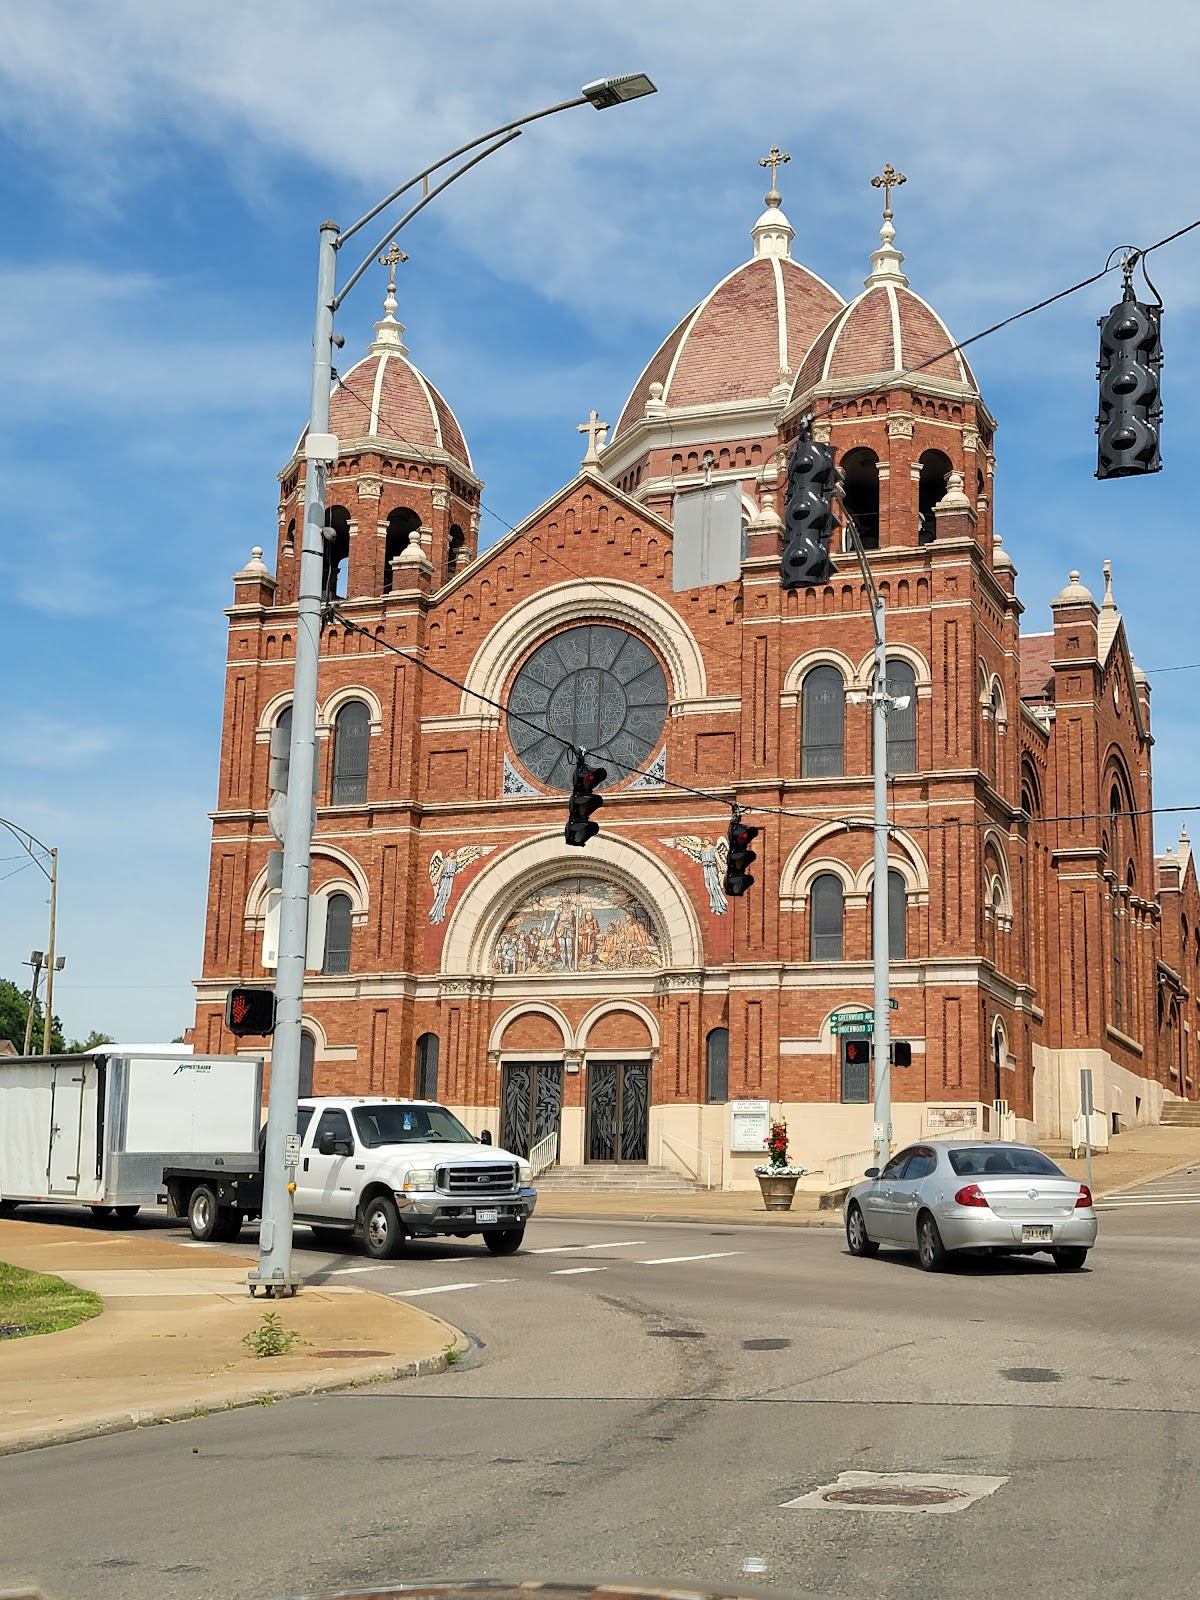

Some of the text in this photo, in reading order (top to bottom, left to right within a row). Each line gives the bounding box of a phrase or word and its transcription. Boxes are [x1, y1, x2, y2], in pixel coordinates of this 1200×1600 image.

[838, 1012, 873, 1021] GREENWOOD AVE
[838, 1024, 873, 1033] UNDERWOOD ST
